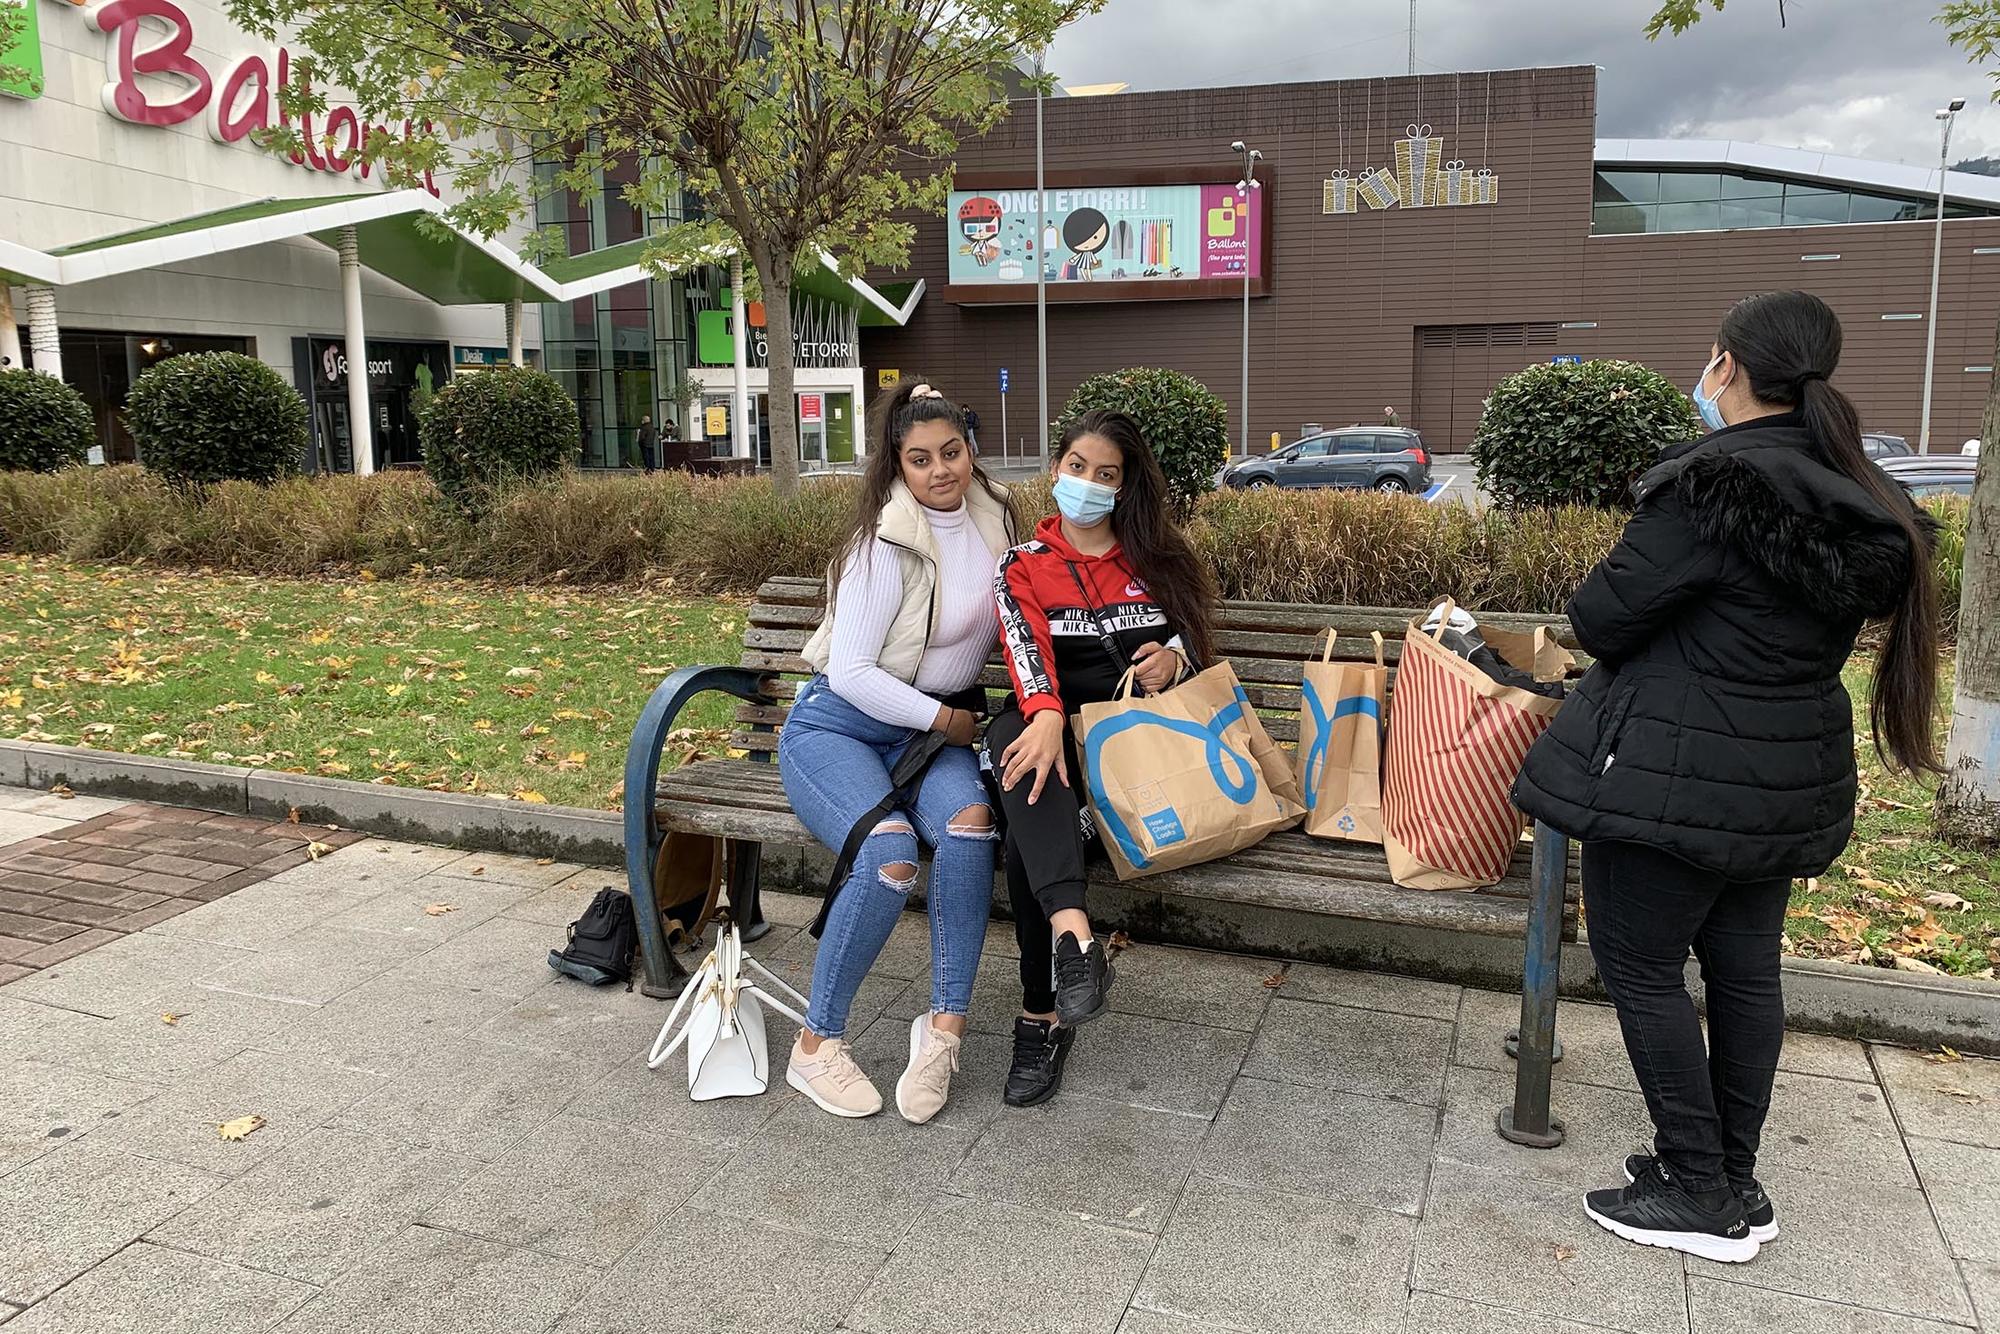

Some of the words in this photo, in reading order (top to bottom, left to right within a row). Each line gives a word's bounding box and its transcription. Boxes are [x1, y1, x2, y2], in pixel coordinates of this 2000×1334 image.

[1056, 189, 1147, 212] ETORRI!
[1207, 239, 1247, 249] Ballont
[802, 342, 853, 357] ETORRI
[368, 358, 393, 377] sport
[1065, 609, 1088, 621] NIKE
[1118, 604, 1145, 616] NIKE
[1062, 621, 1089, 633] NIKE
[1120, 615, 1146, 628] NIKE
[1658, 1162, 1670, 1180] FILA
[1727, 1219, 1746, 1236] FILA
